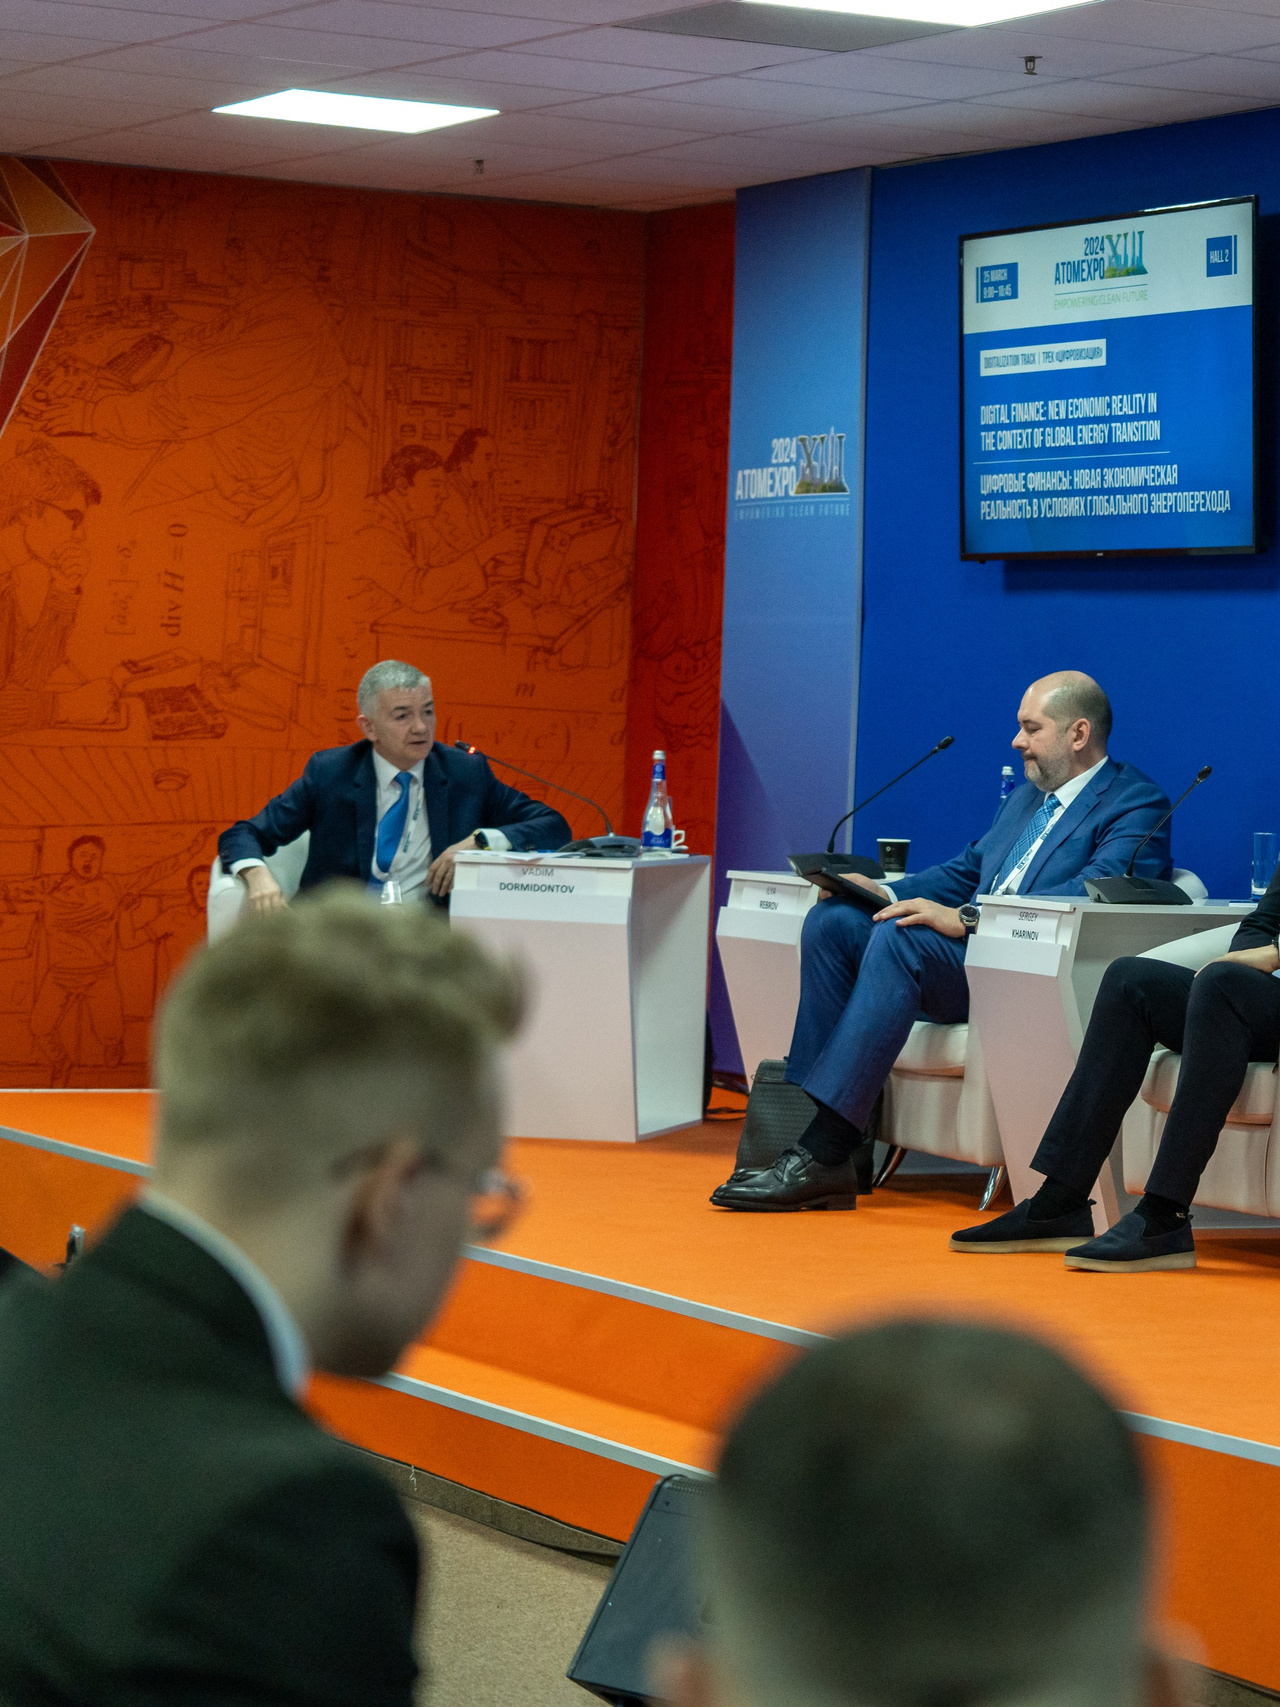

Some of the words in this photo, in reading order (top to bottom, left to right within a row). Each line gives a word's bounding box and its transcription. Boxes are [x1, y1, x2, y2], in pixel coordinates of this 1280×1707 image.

[1085, 236, 1105, 256] 2024
[1210, 250, 1224, 263] HALL
[1225, 249, 1230, 262] 2
[1055, 257, 1105, 285] ATOMEXPO
[1123, 290, 1148, 302] FUTURE
[981, 404, 1009, 425] DIGITAL
[1011, 402, 1047, 423] FINANCE:
[1049, 400, 1067, 420] NEW
[1069, 396, 1110, 419] ECONOMIC
[1112, 393, 1147, 416] REALITY
[1149, 393, 1157, 413] IN
[981, 432, 996, 451] THE
[997, 429, 1033, 450] CONTEXT
[1034, 428, 1044, 448] OF
[1046, 426, 1076, 447] GLOBAL
[1078, 424, 1109, 446] ENERGY
[1111, 420, 1161, 443] TRANSITION
[772, 437, 797, 464] 2024
[736, 466, 797, 501] ATOMEXPO
[981, 472, 1026, 495] ЦИФРОВЫЕ
[1028, 470, 1073, 492] ФИНАНСЫ:
[1074, 468, 1102, 490] НОВАЯ
[1103, 465, 1178, 489] ЭКОНОМИЧЕСКАЯ
[981, 500, 1032, 521] РЕАЛЬНОСТЬ
[1033, 499, 1039, 519] В
[1040, 496, 1085, 519] УСЛОВИЯХ
[1087, 493, 1149, 517] ГЛОБАЛЬНОГО
[1151, 490, 1231, 514] ЭНЕРГОПЕРЕХОДА
[522, 868, 554, 877] VADIM
[500, 882, 575, 894] DORMIDONTOV
[1019, 911, 1039, 923] SERGEY
[1012, 929, 1040, 941] KHARINOV
